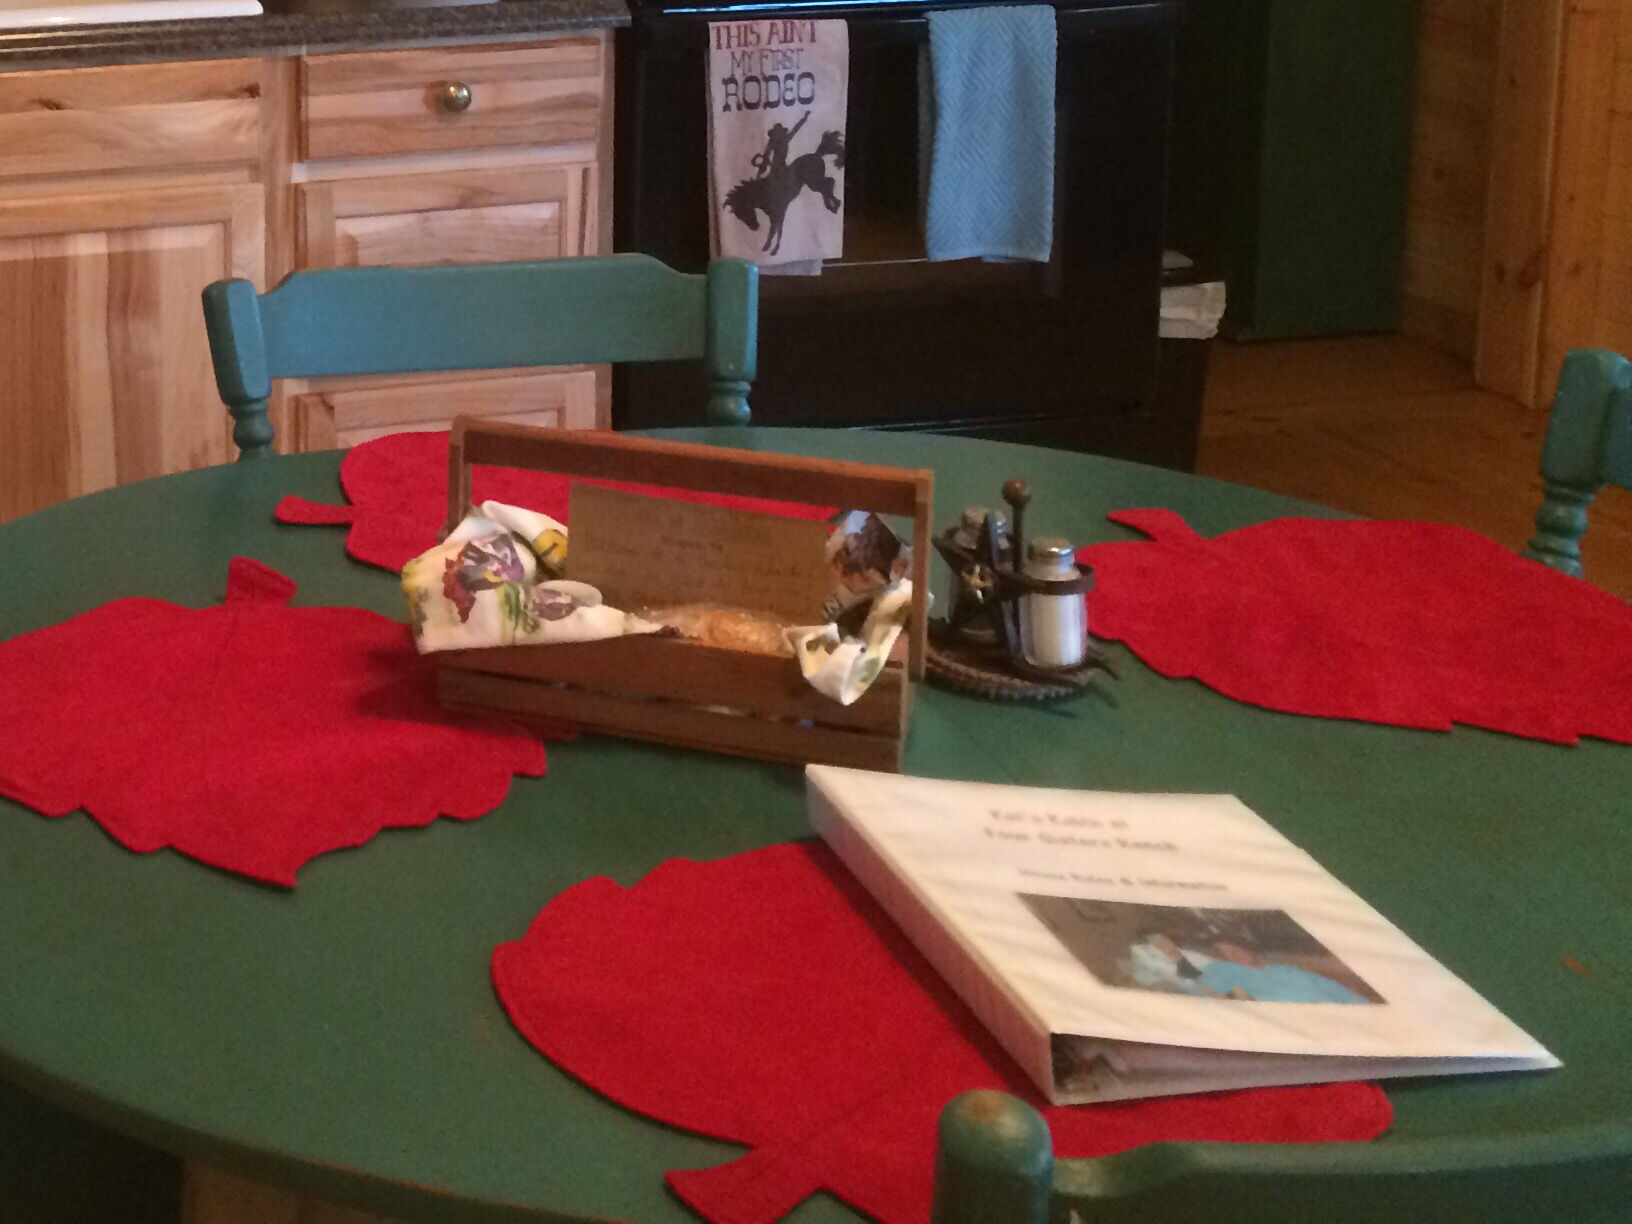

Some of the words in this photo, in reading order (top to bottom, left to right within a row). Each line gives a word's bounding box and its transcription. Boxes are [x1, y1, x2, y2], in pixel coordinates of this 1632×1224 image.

[712, 22, 761, 50] THIS
[730, 49, 754, 76] MY
[759, 47, 805, 76] FIRST
[722, 71, 816, 112] RODEO
[1114, 836, 1181, 853] Ranch
